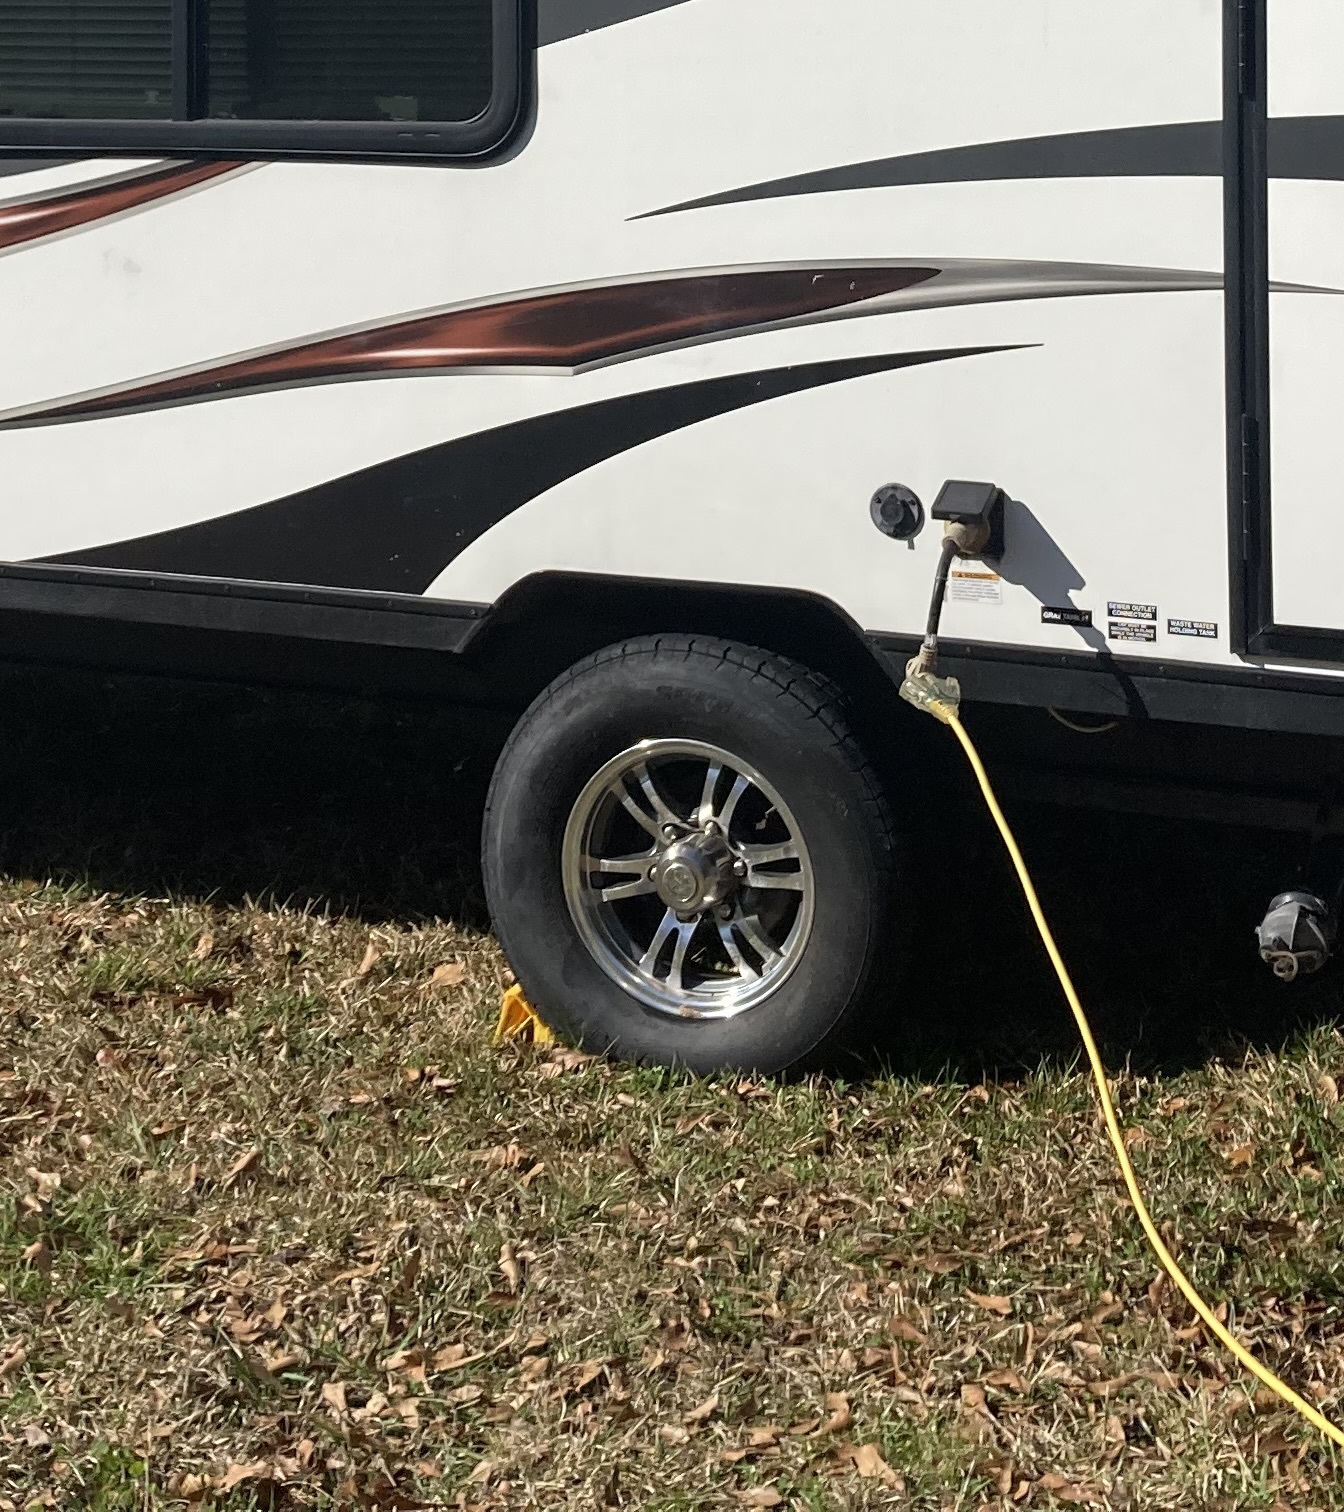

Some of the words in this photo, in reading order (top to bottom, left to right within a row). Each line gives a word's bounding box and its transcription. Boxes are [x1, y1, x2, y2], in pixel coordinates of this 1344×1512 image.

[1131, 604, 1156, 613] OUTLET
[1111, 609, 1153, 619] CONNECTION
[1170, 620, 1192, 628] WASTE
[1192, 622, 1215, 630] WATER
[1169, 626, 1198, 635] HOLDING
